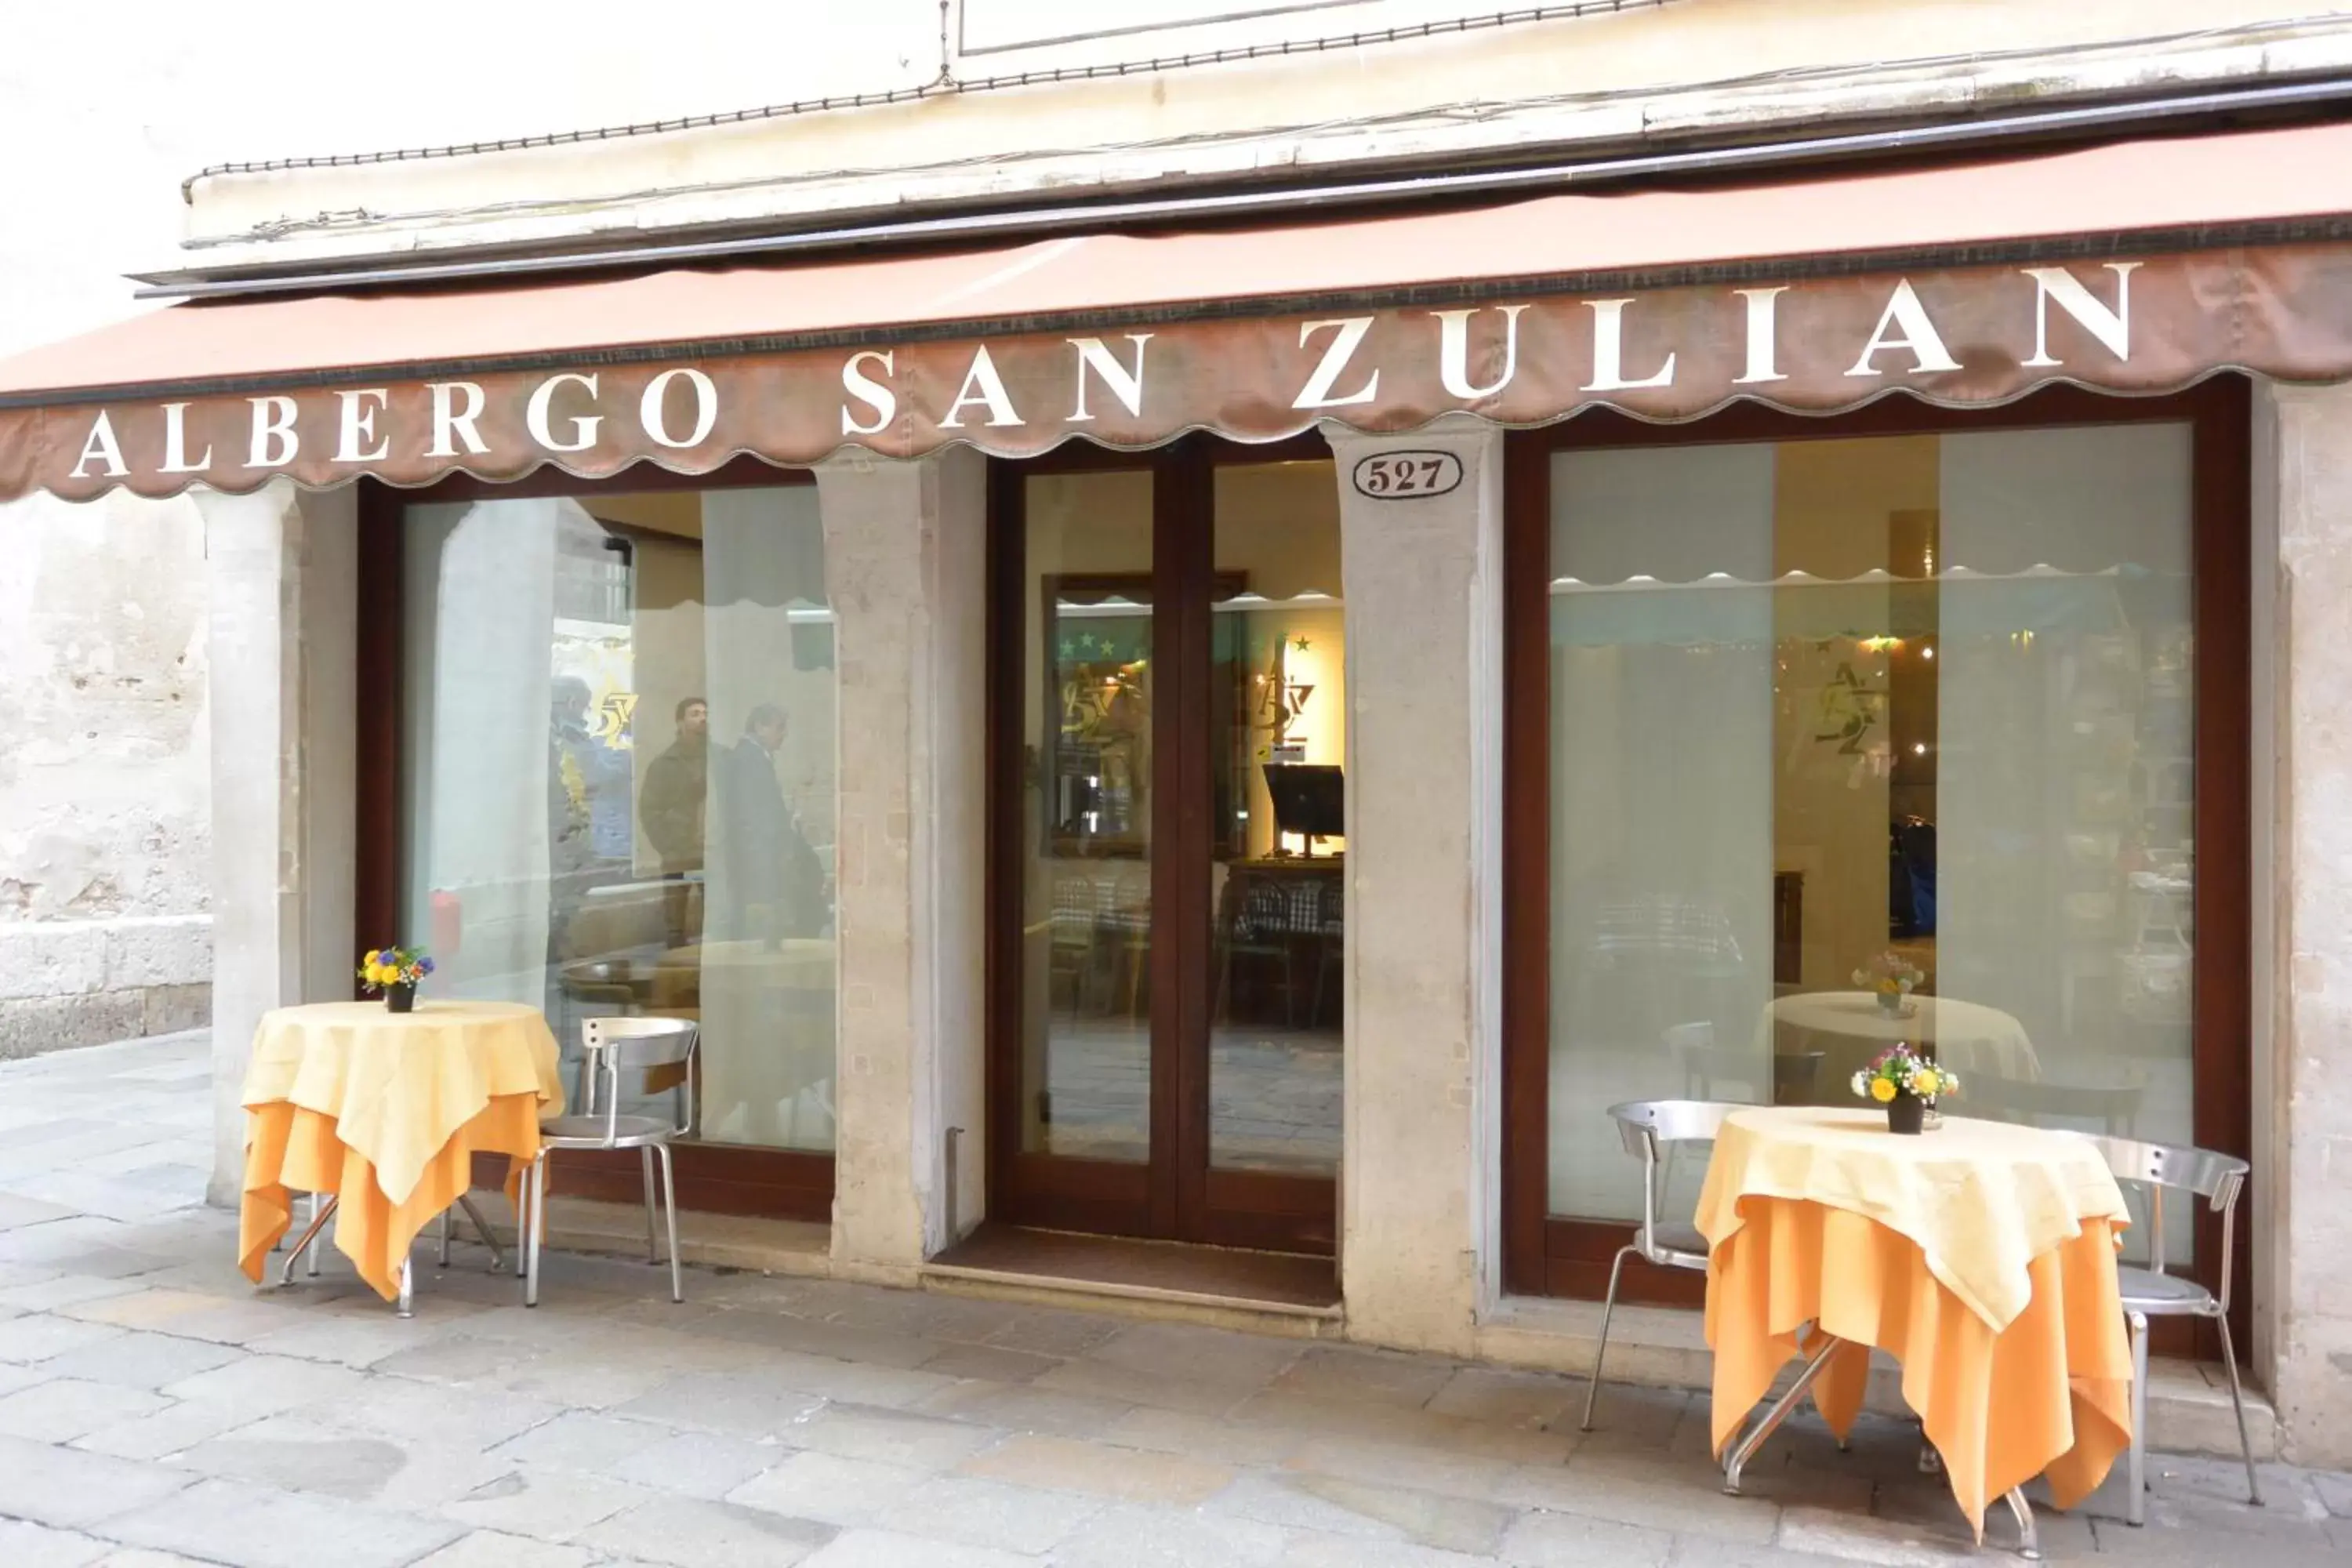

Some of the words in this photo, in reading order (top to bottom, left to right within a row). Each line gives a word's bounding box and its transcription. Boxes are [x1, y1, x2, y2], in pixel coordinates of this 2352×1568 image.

[67, 368, 718, 479] ALBERGO
[841, 333, 1155, 437] SAN
[1291, 262, 2144, 409] ZULIAN
[1367, 459, 1443, 493] 527
